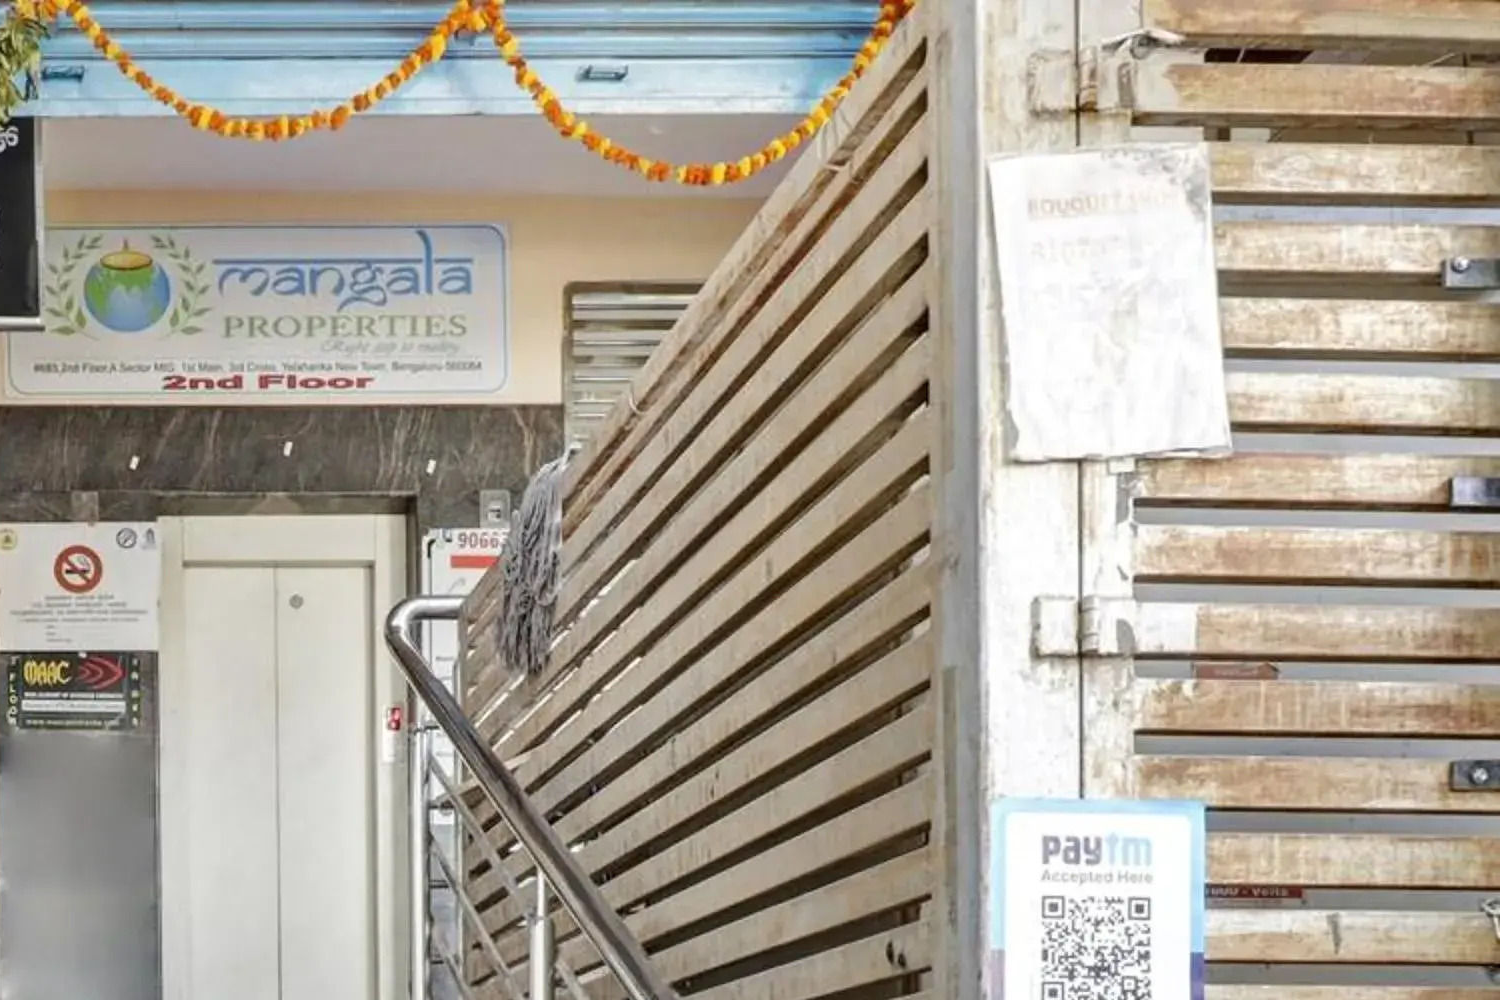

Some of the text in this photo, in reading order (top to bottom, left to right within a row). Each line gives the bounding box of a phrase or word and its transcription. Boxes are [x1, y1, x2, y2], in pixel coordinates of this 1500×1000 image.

[212, 230, 474, 313] mangala
[223, 314, 468, 338] PROPERTIES
[161, 374, 375, 391] 2nd Floor
[1041, 832, 1152, 866] paytm
[1041, 869, 1154, 885] Accepted Here
